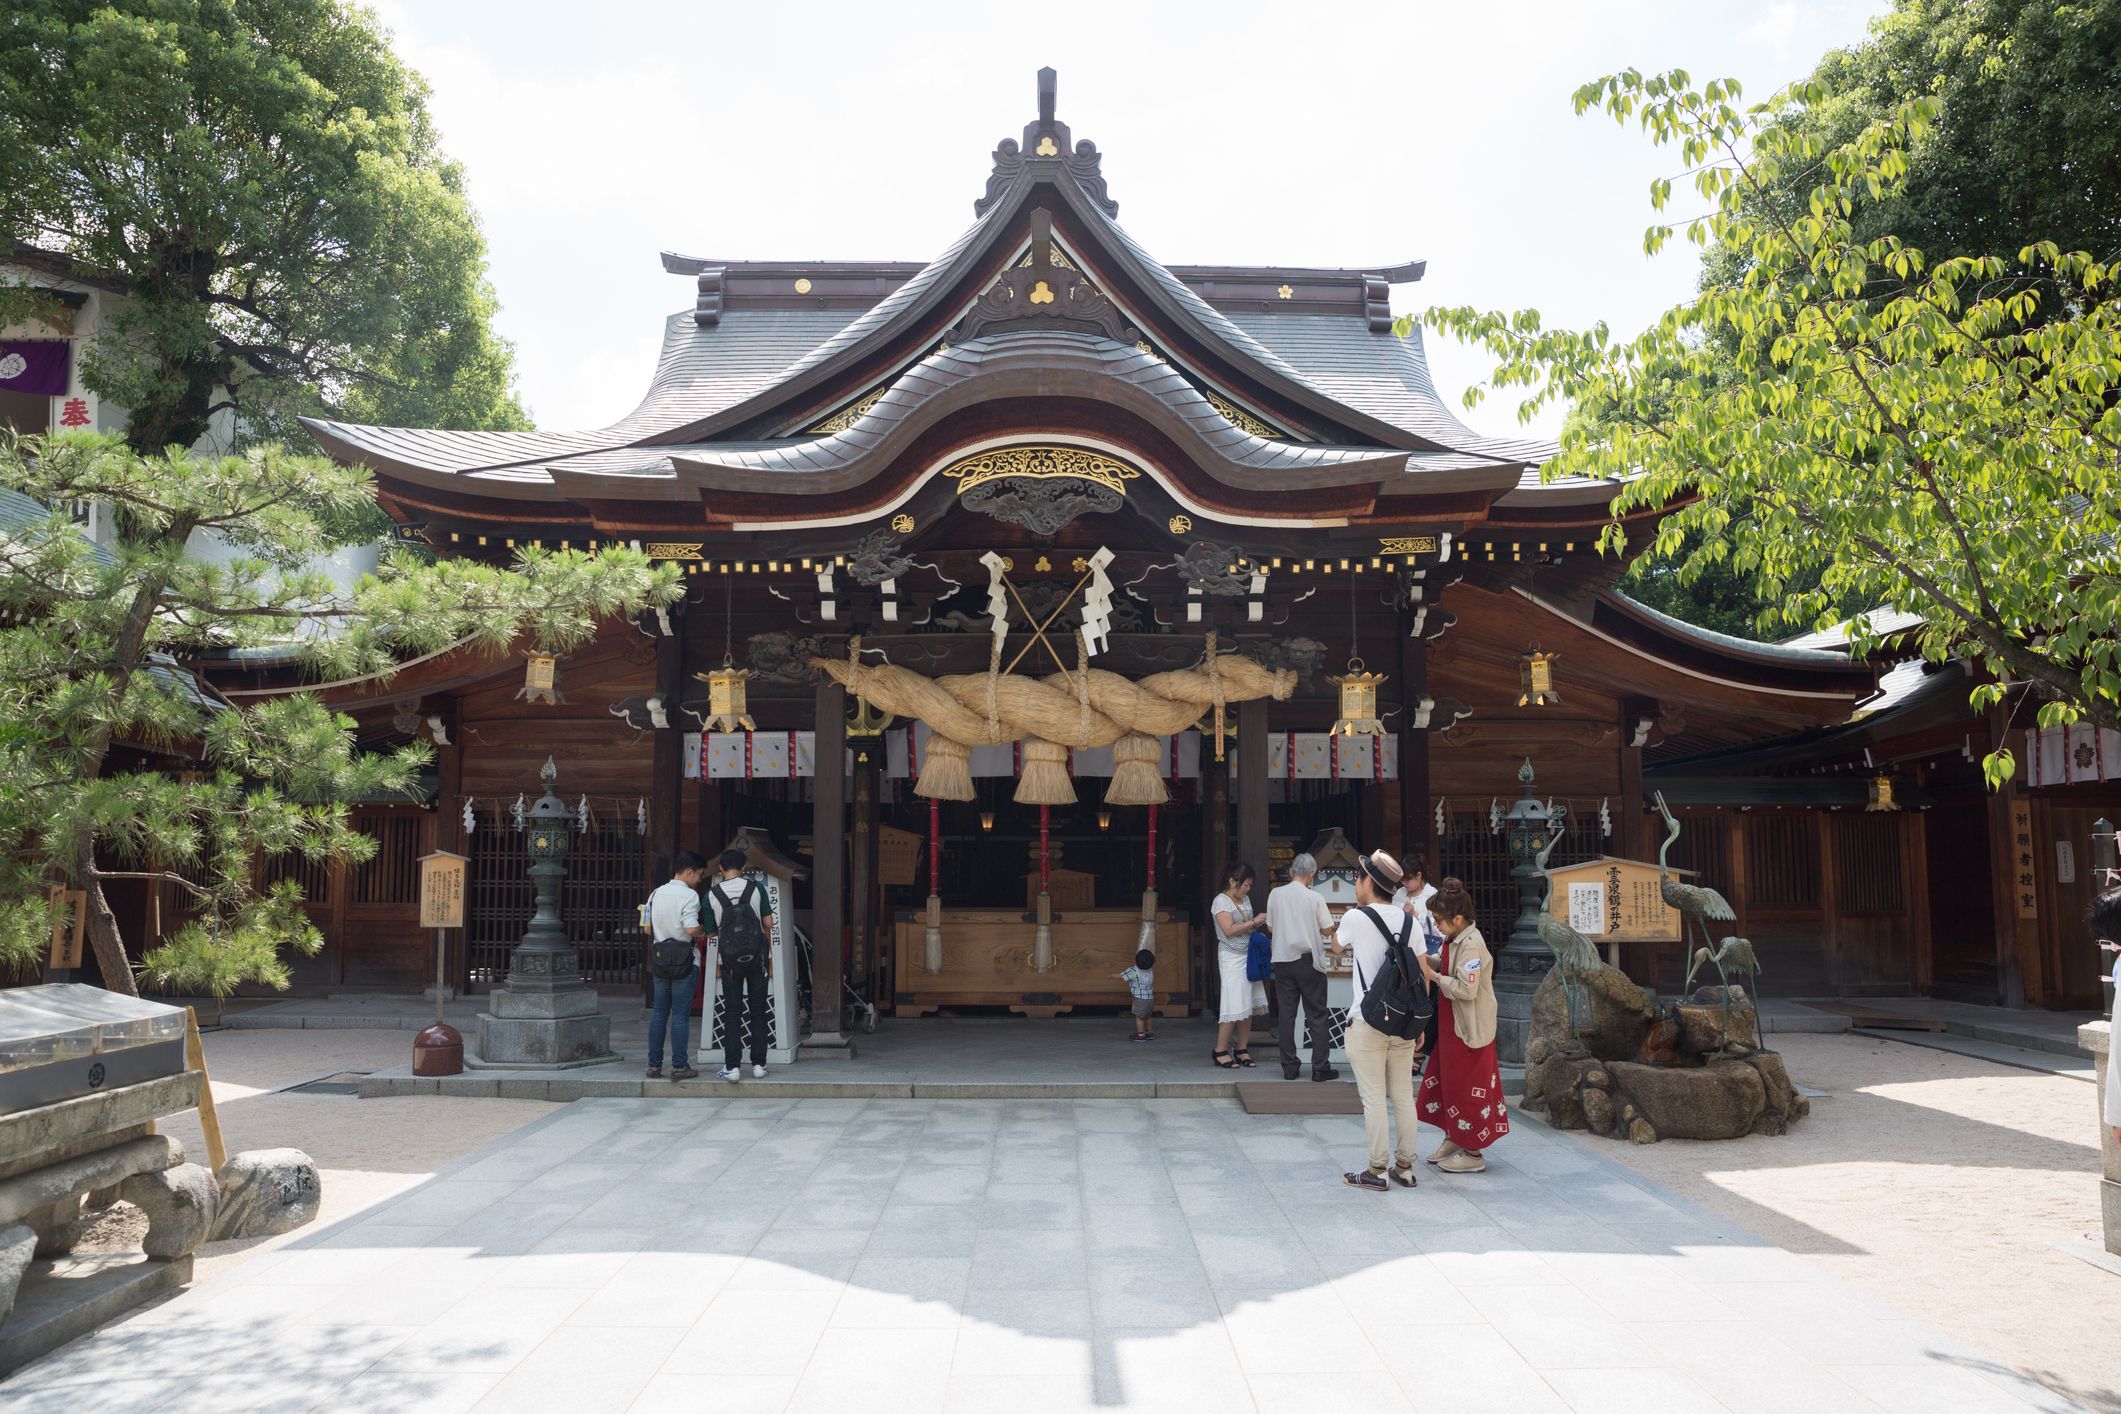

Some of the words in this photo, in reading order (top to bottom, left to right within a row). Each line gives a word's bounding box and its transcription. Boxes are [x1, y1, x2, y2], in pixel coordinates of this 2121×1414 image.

[60, 397, 91, 429] 奉
[2016, 813, 2034, 908] 祈願者控室
